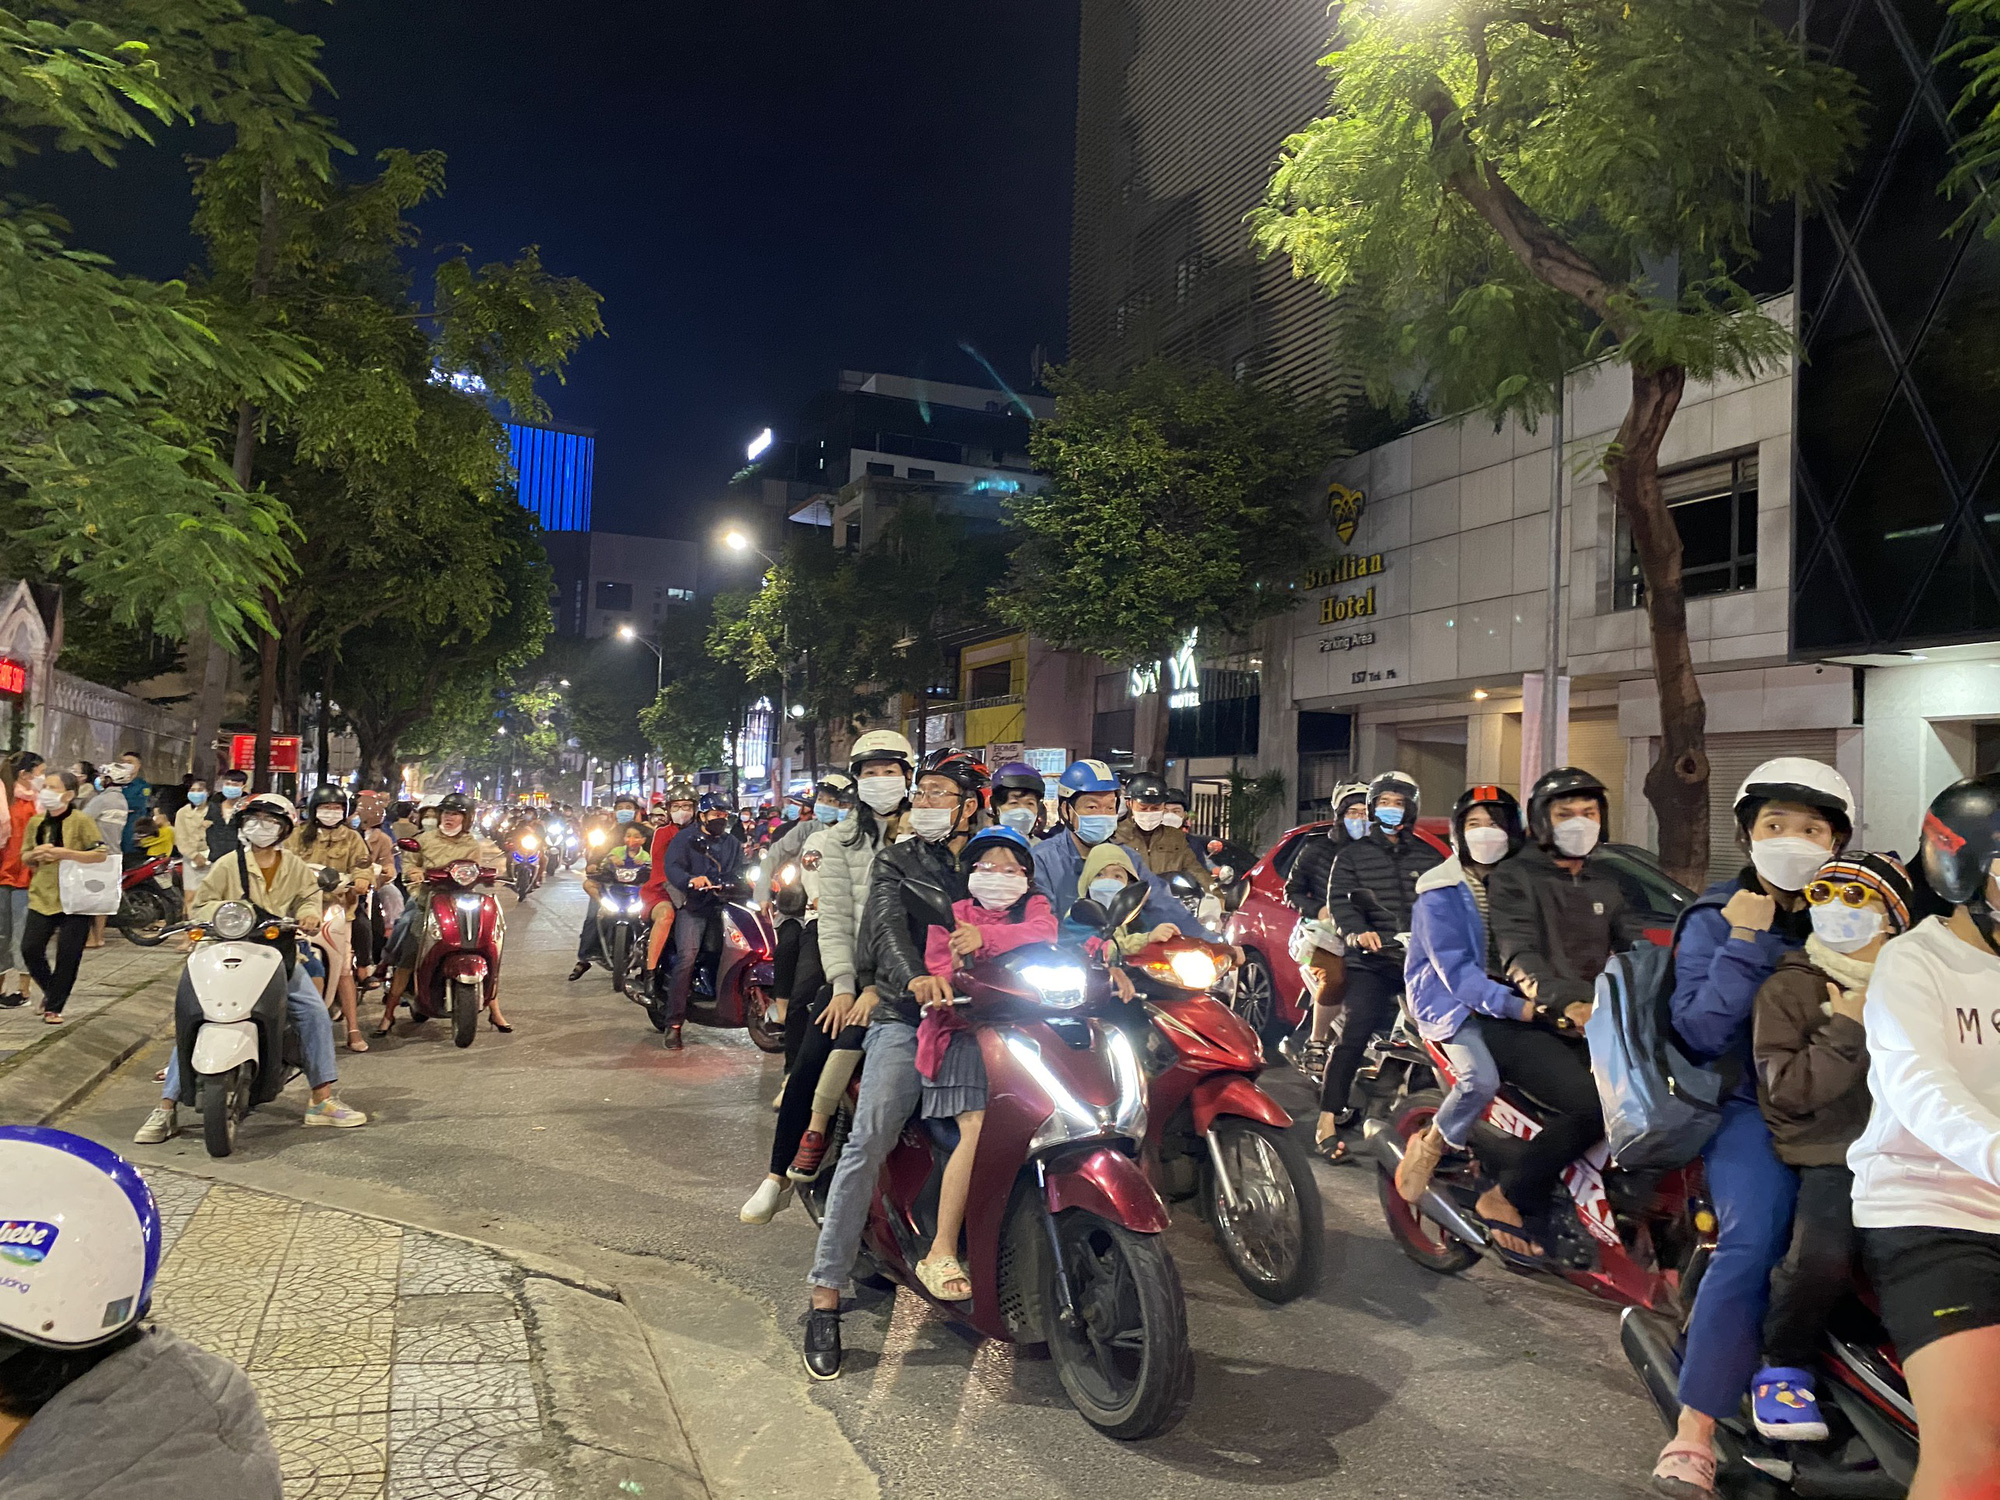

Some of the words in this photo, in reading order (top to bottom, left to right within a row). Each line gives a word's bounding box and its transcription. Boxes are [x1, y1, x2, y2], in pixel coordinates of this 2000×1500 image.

[1319, 588, 1373, 624] Hotel
[1319, 637, 1350, 651] Parking
[1352, 633, 1373, 645] Area
[1352, 671, 1368, 685] 157
[1169, 690, 1201, 709] HOTEL
